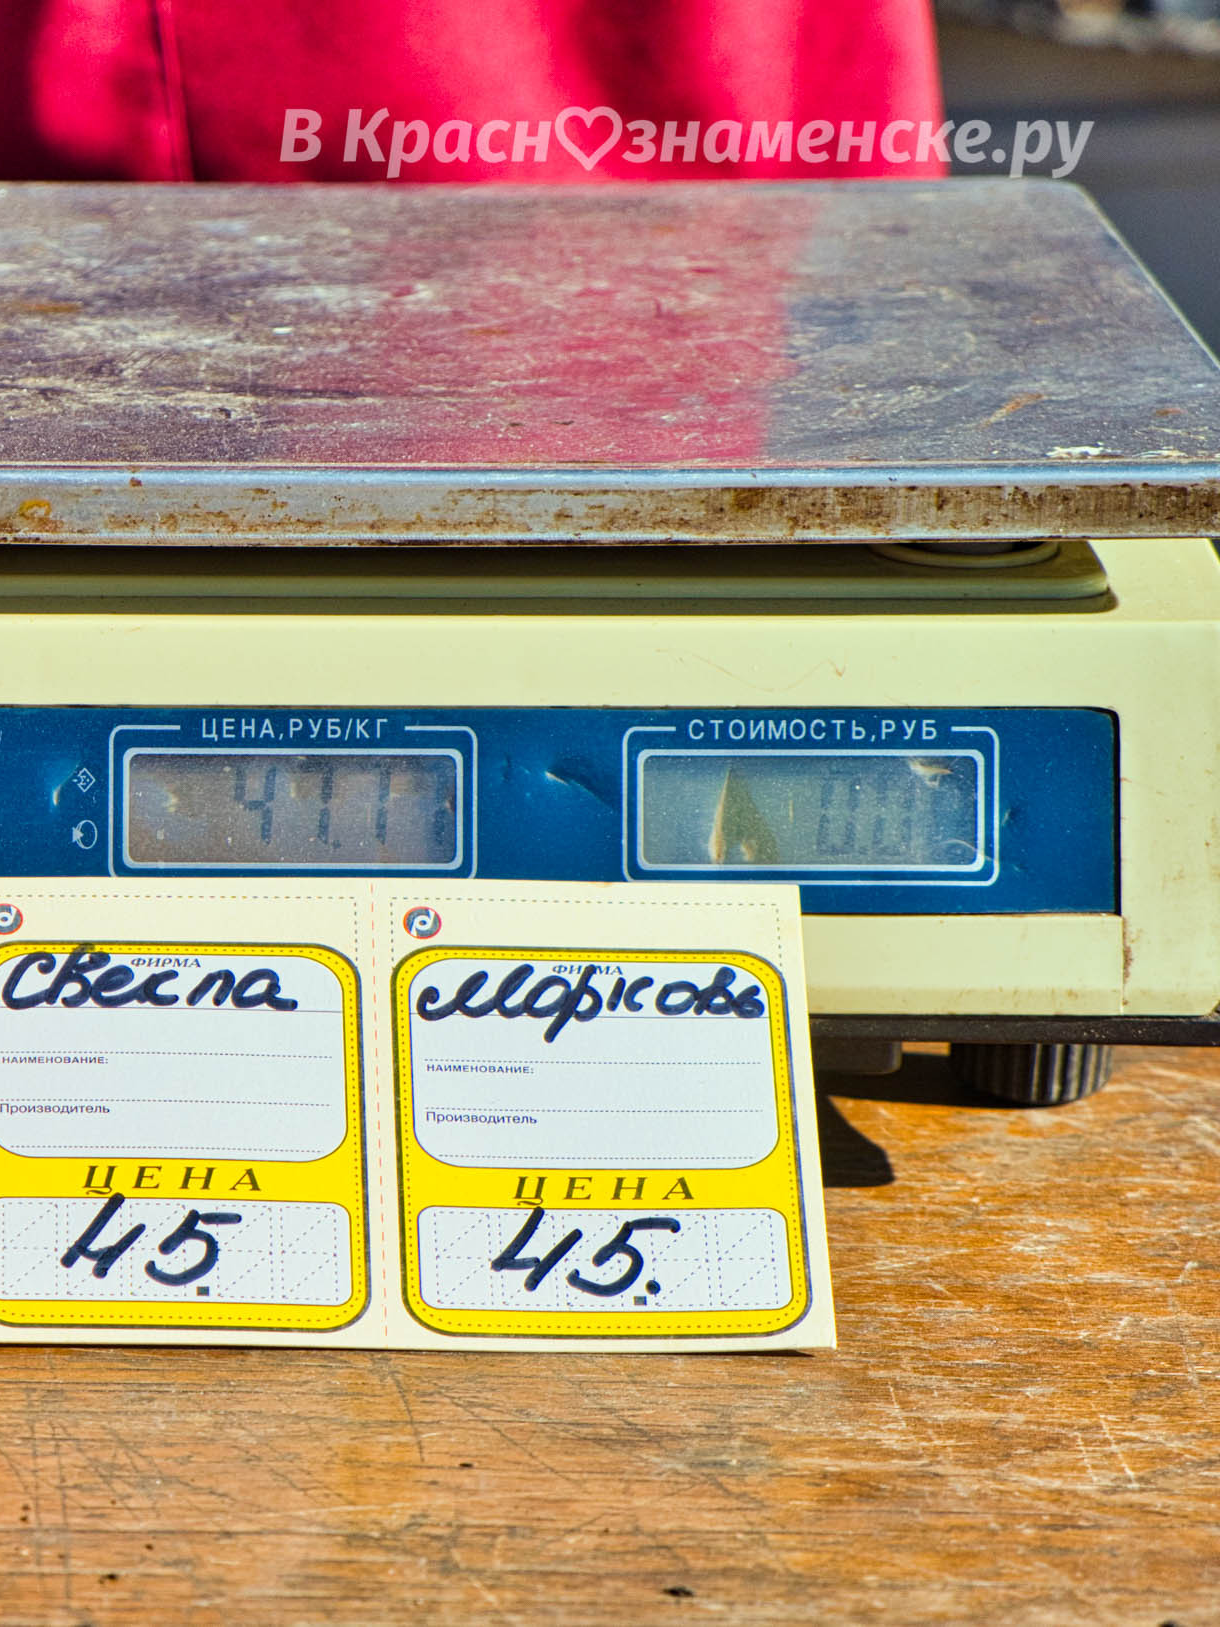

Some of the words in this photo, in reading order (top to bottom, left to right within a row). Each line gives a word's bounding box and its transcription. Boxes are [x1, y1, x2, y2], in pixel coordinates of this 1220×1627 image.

[130, 956, 202, 969] ФИРМА
[551, 964, 624, 976] ФИМА
[1, 1056, 109, 1065] НАИМЕНОВАНИЕ:
[426, 1064, 534, 1074] НАИМЕНОВАНИЕ:
[0, 1103, 110, 1115] Производитель
[426, 1111, 537, 1125] Производитель
[83, 1165, 261, 1195] ЦЕНА
[513, 1176, 694, 1206] ЦЕНА
